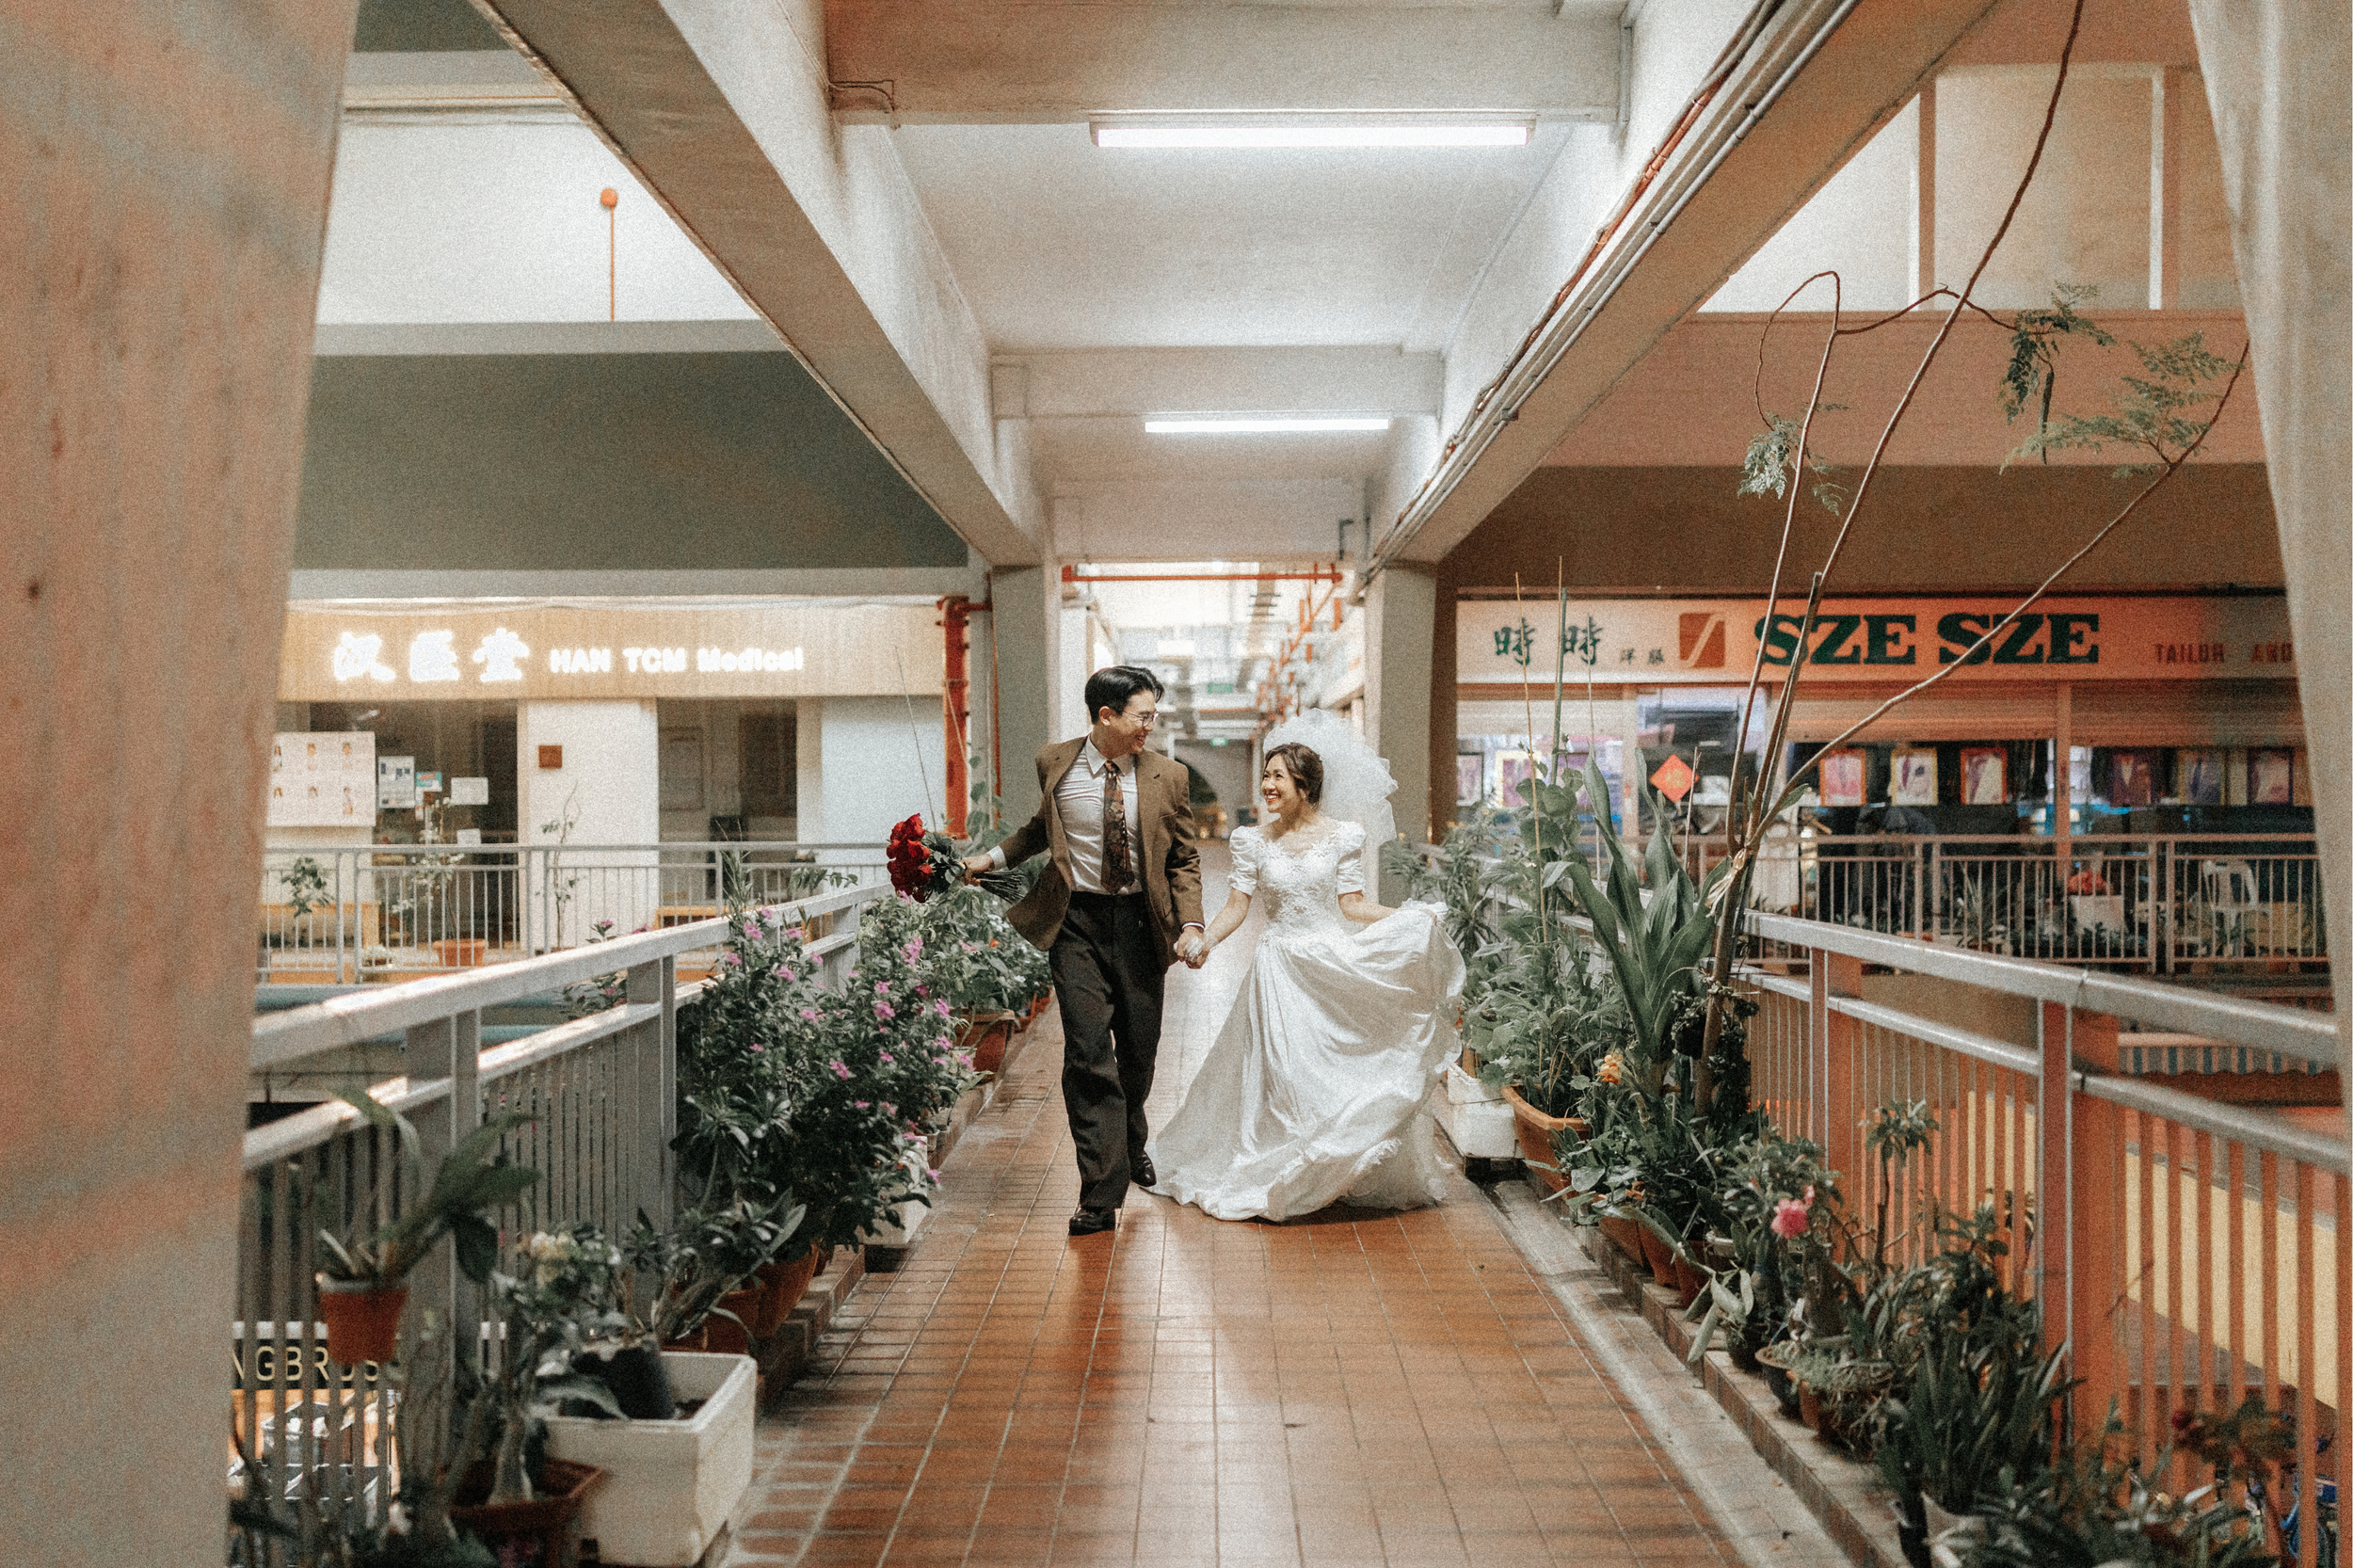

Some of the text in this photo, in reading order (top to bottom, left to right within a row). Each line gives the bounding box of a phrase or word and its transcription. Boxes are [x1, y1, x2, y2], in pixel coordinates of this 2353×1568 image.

[1754, 614, 1916, 664] SZE
[1937, 613, 2099, 664] SZE
[2156, 643, 2225, 664] TAILOR
[550, 647, 804, 674] HAN TCM Medical
